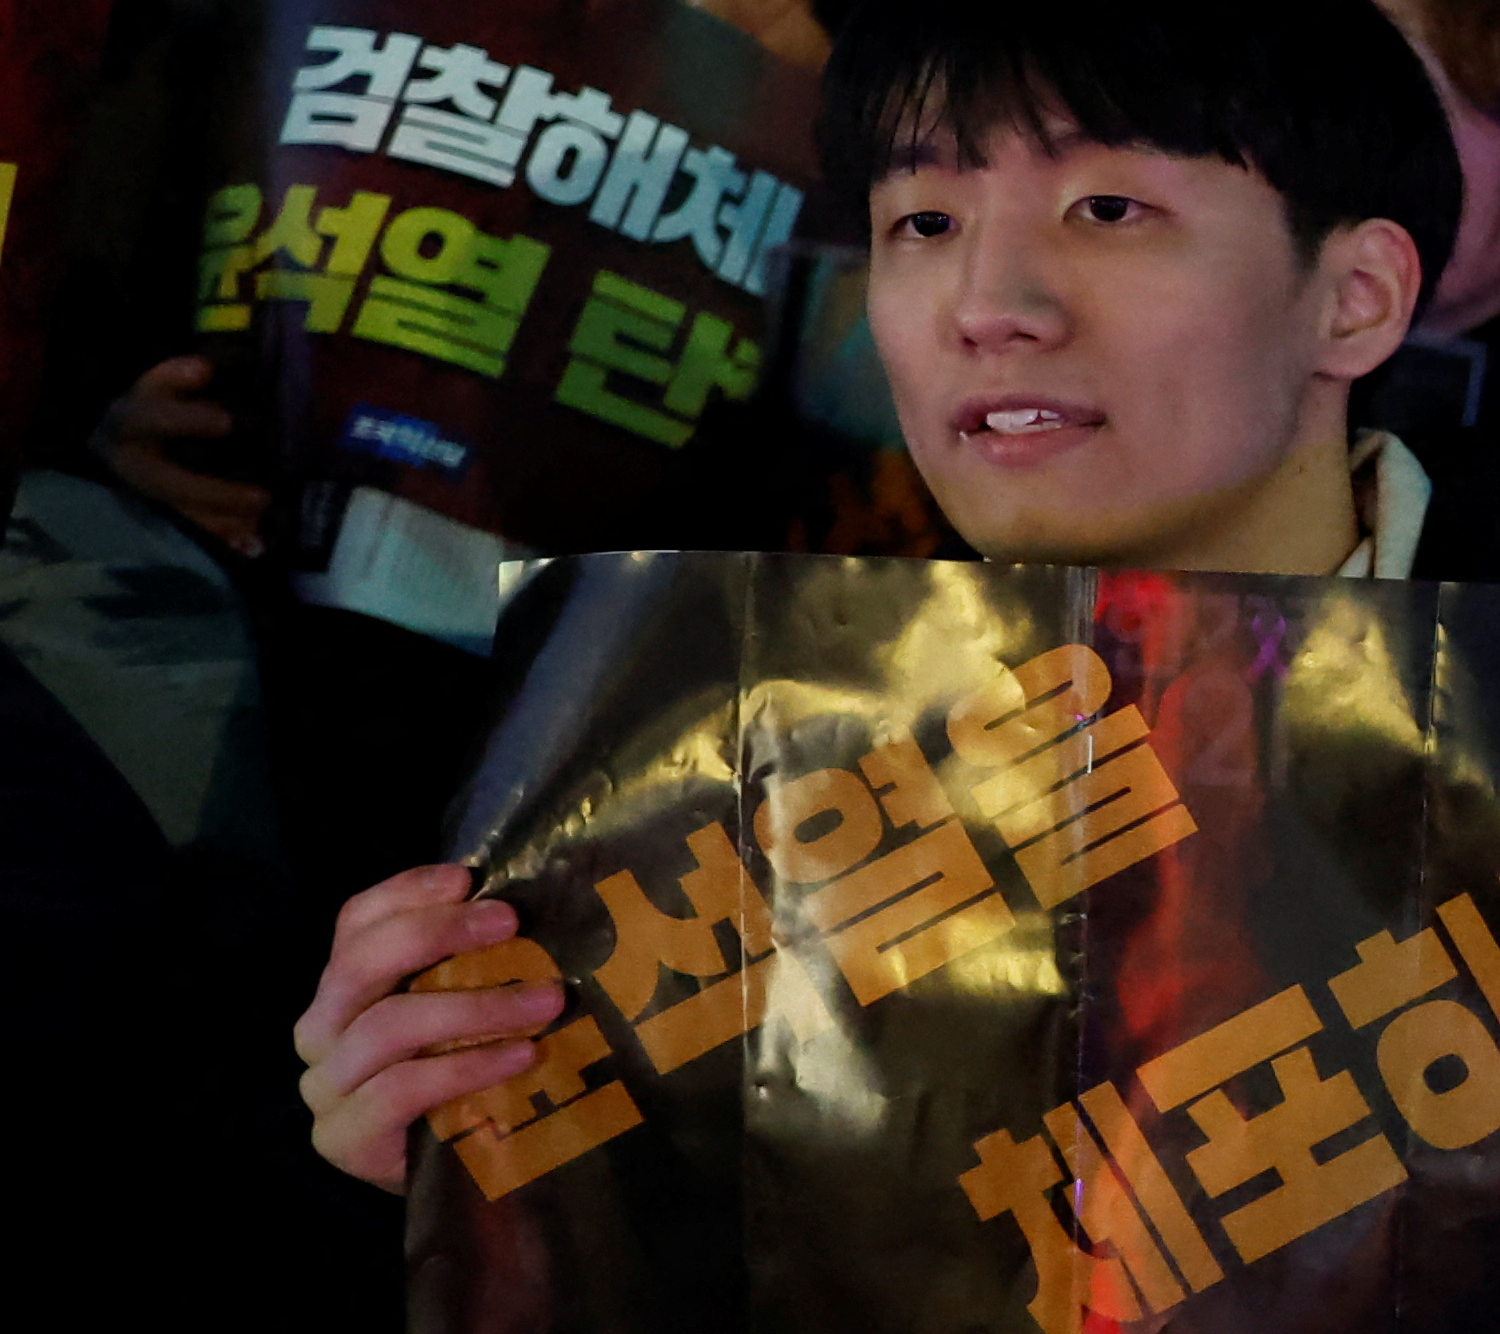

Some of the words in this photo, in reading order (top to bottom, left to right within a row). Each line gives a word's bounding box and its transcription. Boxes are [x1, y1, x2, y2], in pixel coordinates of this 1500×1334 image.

[279, 24, 804, 298] 검찰해체
[194, 183, 552, 380] 윤석열
[555, 270, 763, 451] 탄
[408, 643, 1199, 1203] 윤석열을
